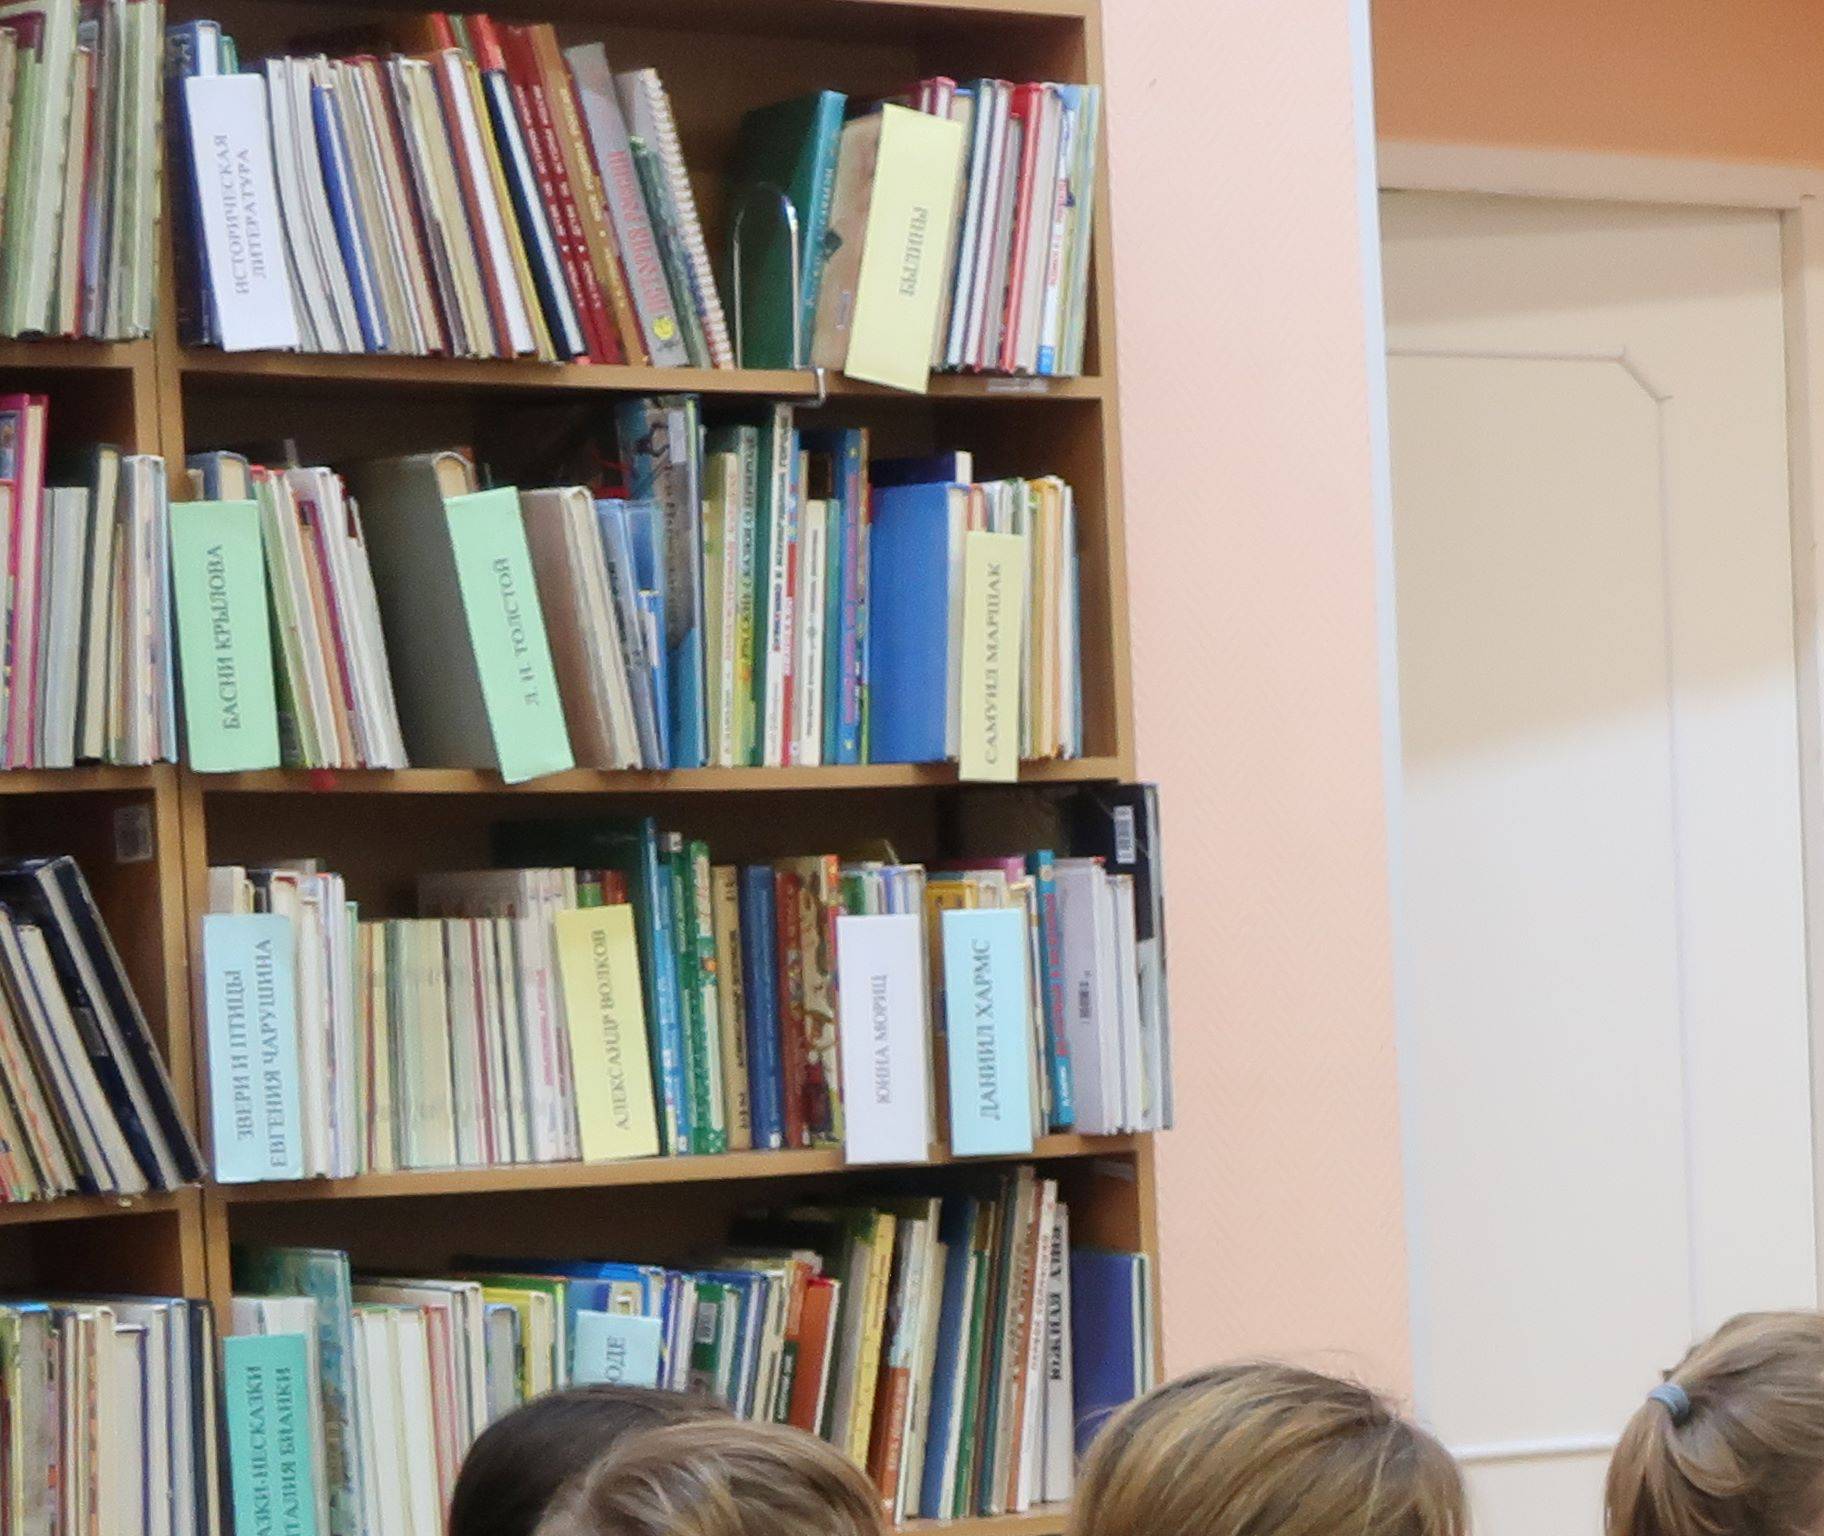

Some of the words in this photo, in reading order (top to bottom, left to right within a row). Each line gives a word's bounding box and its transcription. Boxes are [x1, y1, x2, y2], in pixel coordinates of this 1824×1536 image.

[216, 134, 251, 295] ИСТОРИЧЕСКАЯ
[239, 148, 266, 280] ЛИТЕРАТУРА
[898, 205, 929, 298] БЫЛИНЫ
[207, 543, 233, 651] КРЫЛОВА
[493, 557, 529, 658] ТОЛСТОЙ
[986, 562, 1002, 665] МАРШАК
[214, 656, 240, 732] БАСНИ
[983, 667, 1000, 766] САМУИЛ
[226, 969, 246, 1051] ПТИЦЫ
[257, 938, 280, 1070] ЧАРУШИНА
[590, 929, 615, 1011] ВОЛКОВ
[870, 975, 888, 1042] МОРИЦ
[971, 938, 993, 1019] ХАРМС
[232, 1053, 247, 1071] И
[234, 1073, 256, 1142] ЗВЕРИ
[603, 1010, 630, 1131] АЛЕКСАНДР
[875, 1044, 891, 1104] ЮННА
[976, 1022, 1000, 1121] ДАНИИЛ
[265, 1070, 287, 1169] ЕВГЕНИЯ
[605, 1336, 626, 1383] ОДЕ
[276, 1366, 298, 1457] БИАНКИ
